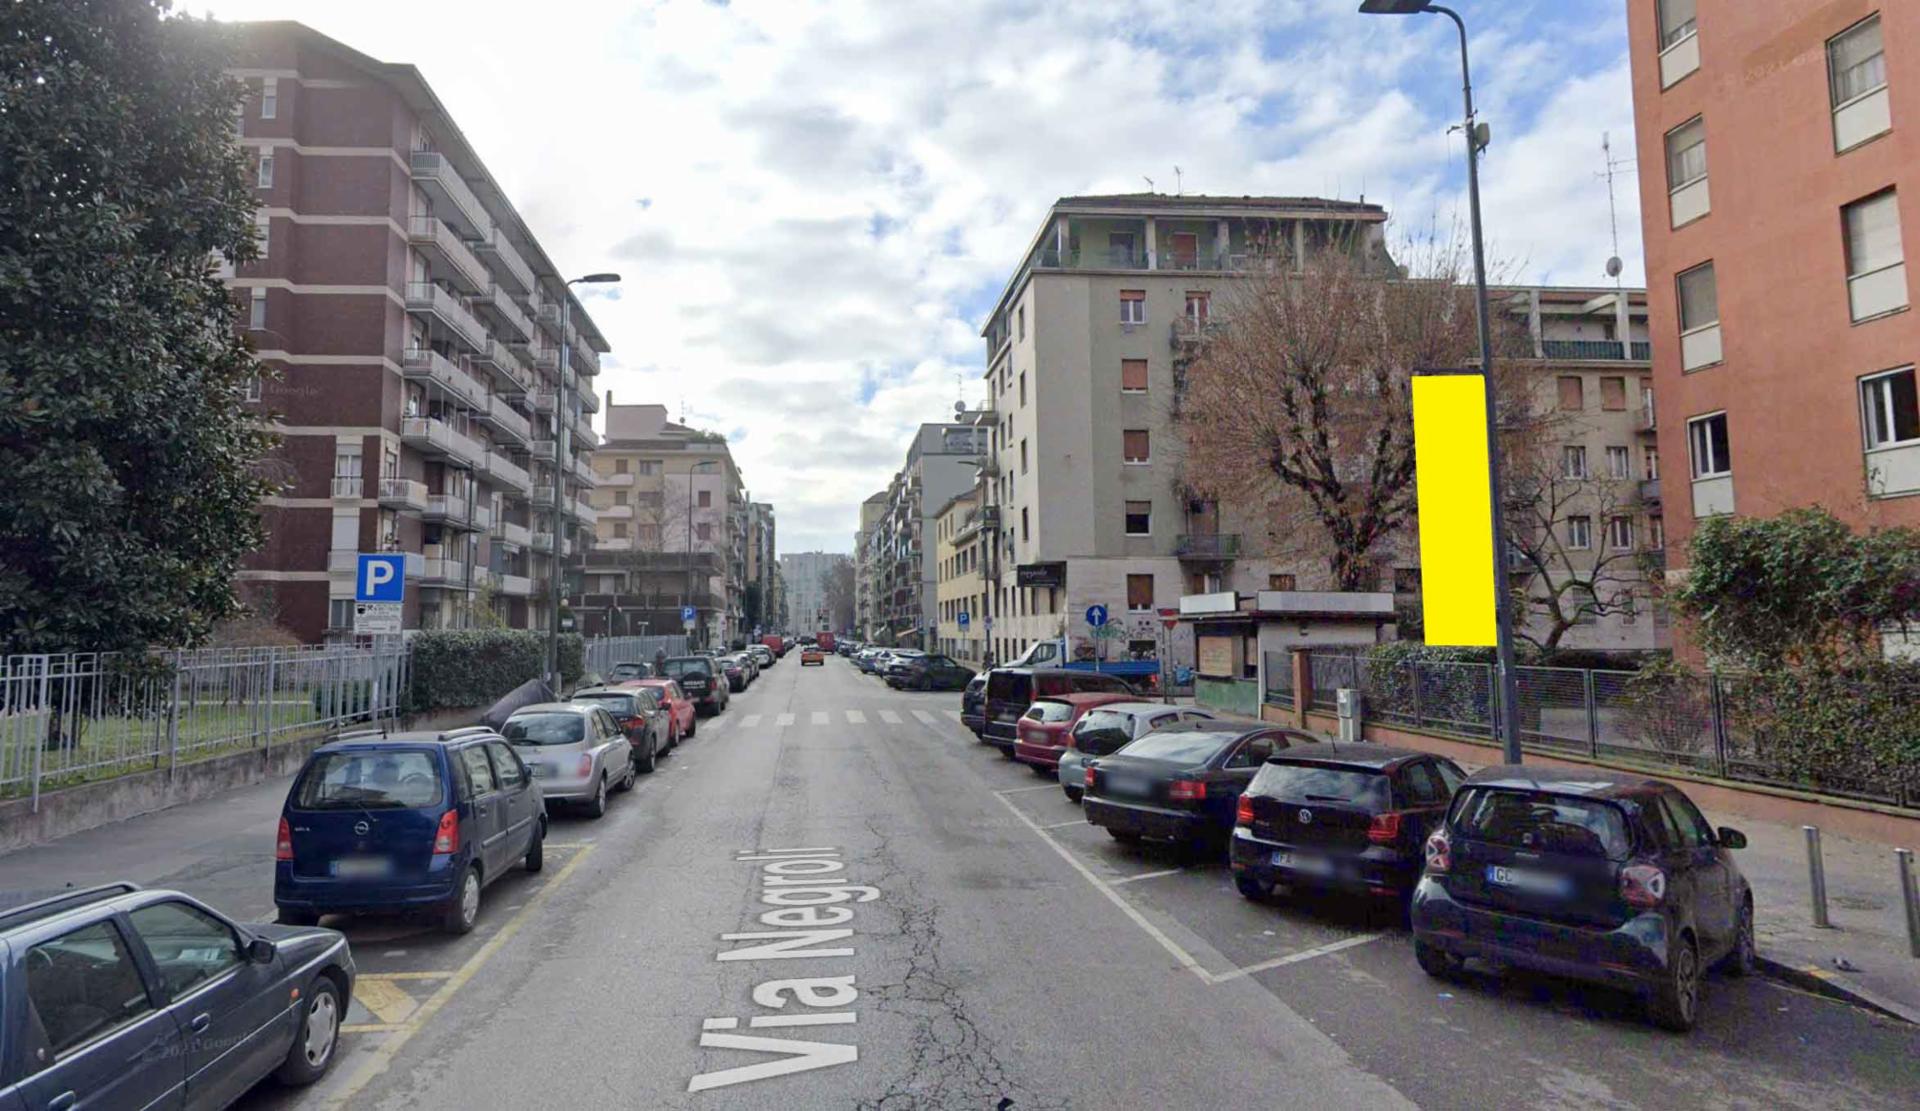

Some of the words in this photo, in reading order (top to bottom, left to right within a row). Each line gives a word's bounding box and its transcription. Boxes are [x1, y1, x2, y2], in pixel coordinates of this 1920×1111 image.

[366, 560, 394, 596] P
[684, 607, 693, 619] P
[959, 614, 968, 623] P
